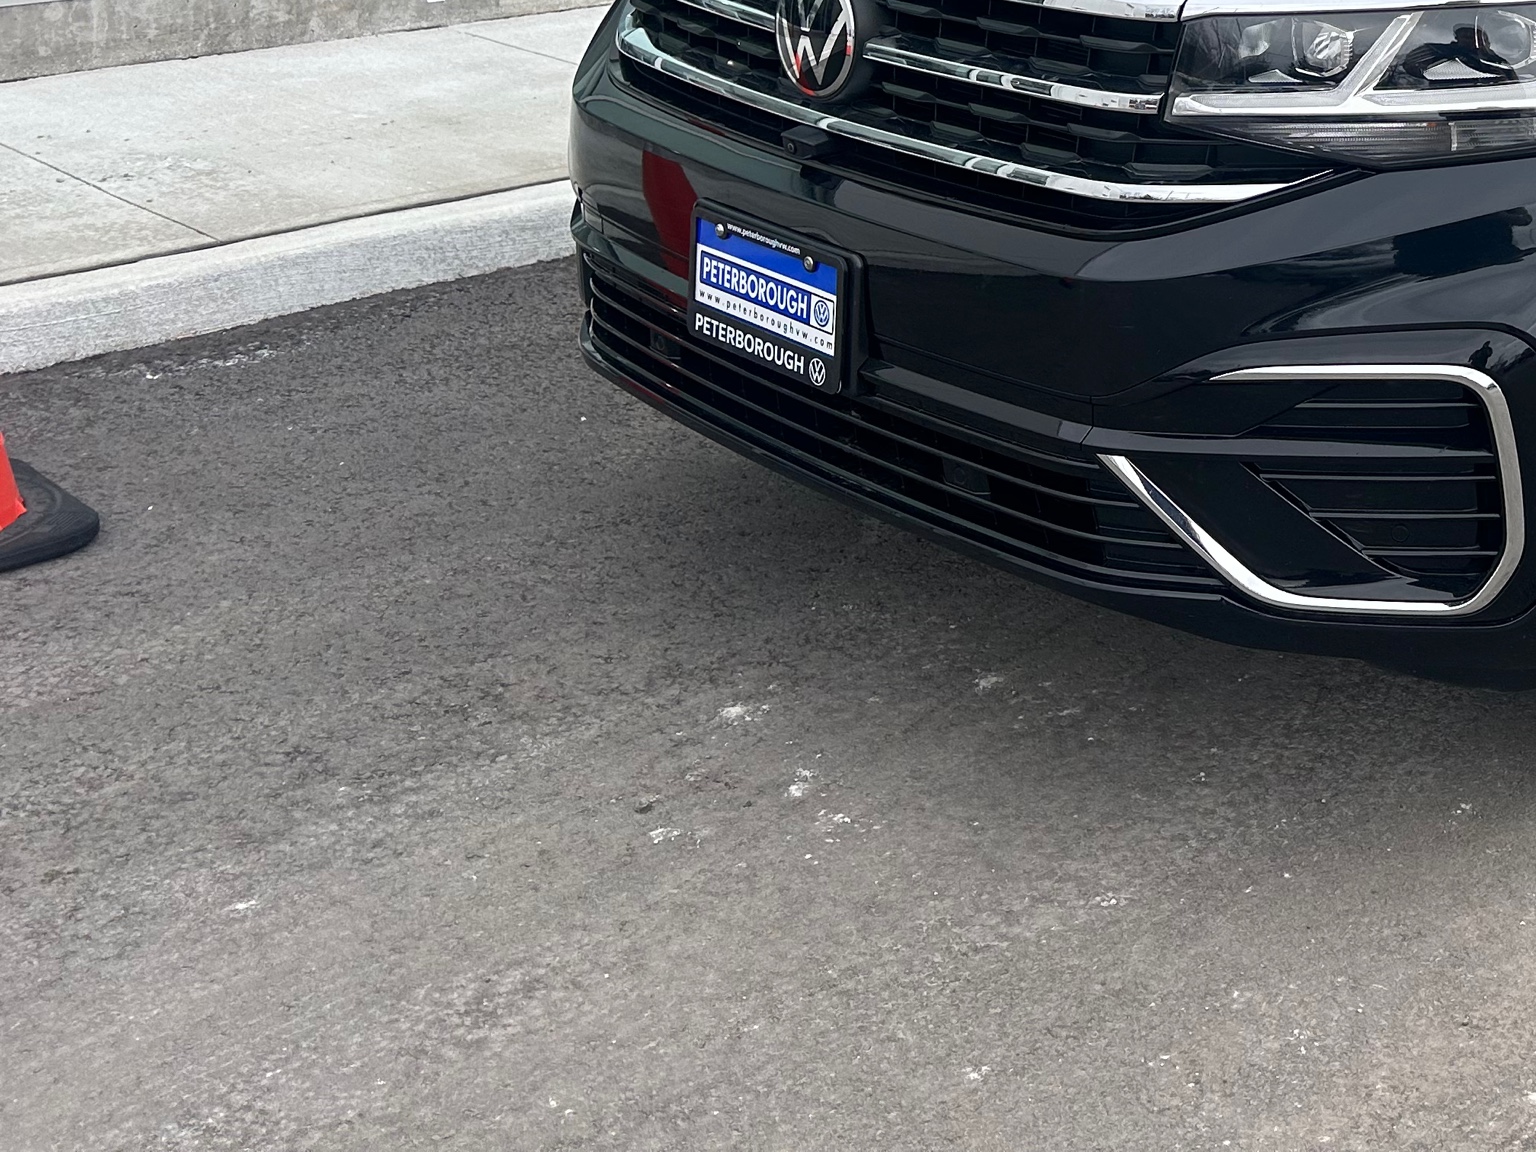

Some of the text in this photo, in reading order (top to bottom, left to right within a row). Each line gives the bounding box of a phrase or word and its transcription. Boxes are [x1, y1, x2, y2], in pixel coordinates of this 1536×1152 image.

[727, 222, 801, 255] www.peterboroughvw.com
[702, 256, 808, 319] PETERBOROUGH
[694, 313, 805, 375] PETERBOROUGH
[699, 289, 833, 350] www.peterboroughvw.com
